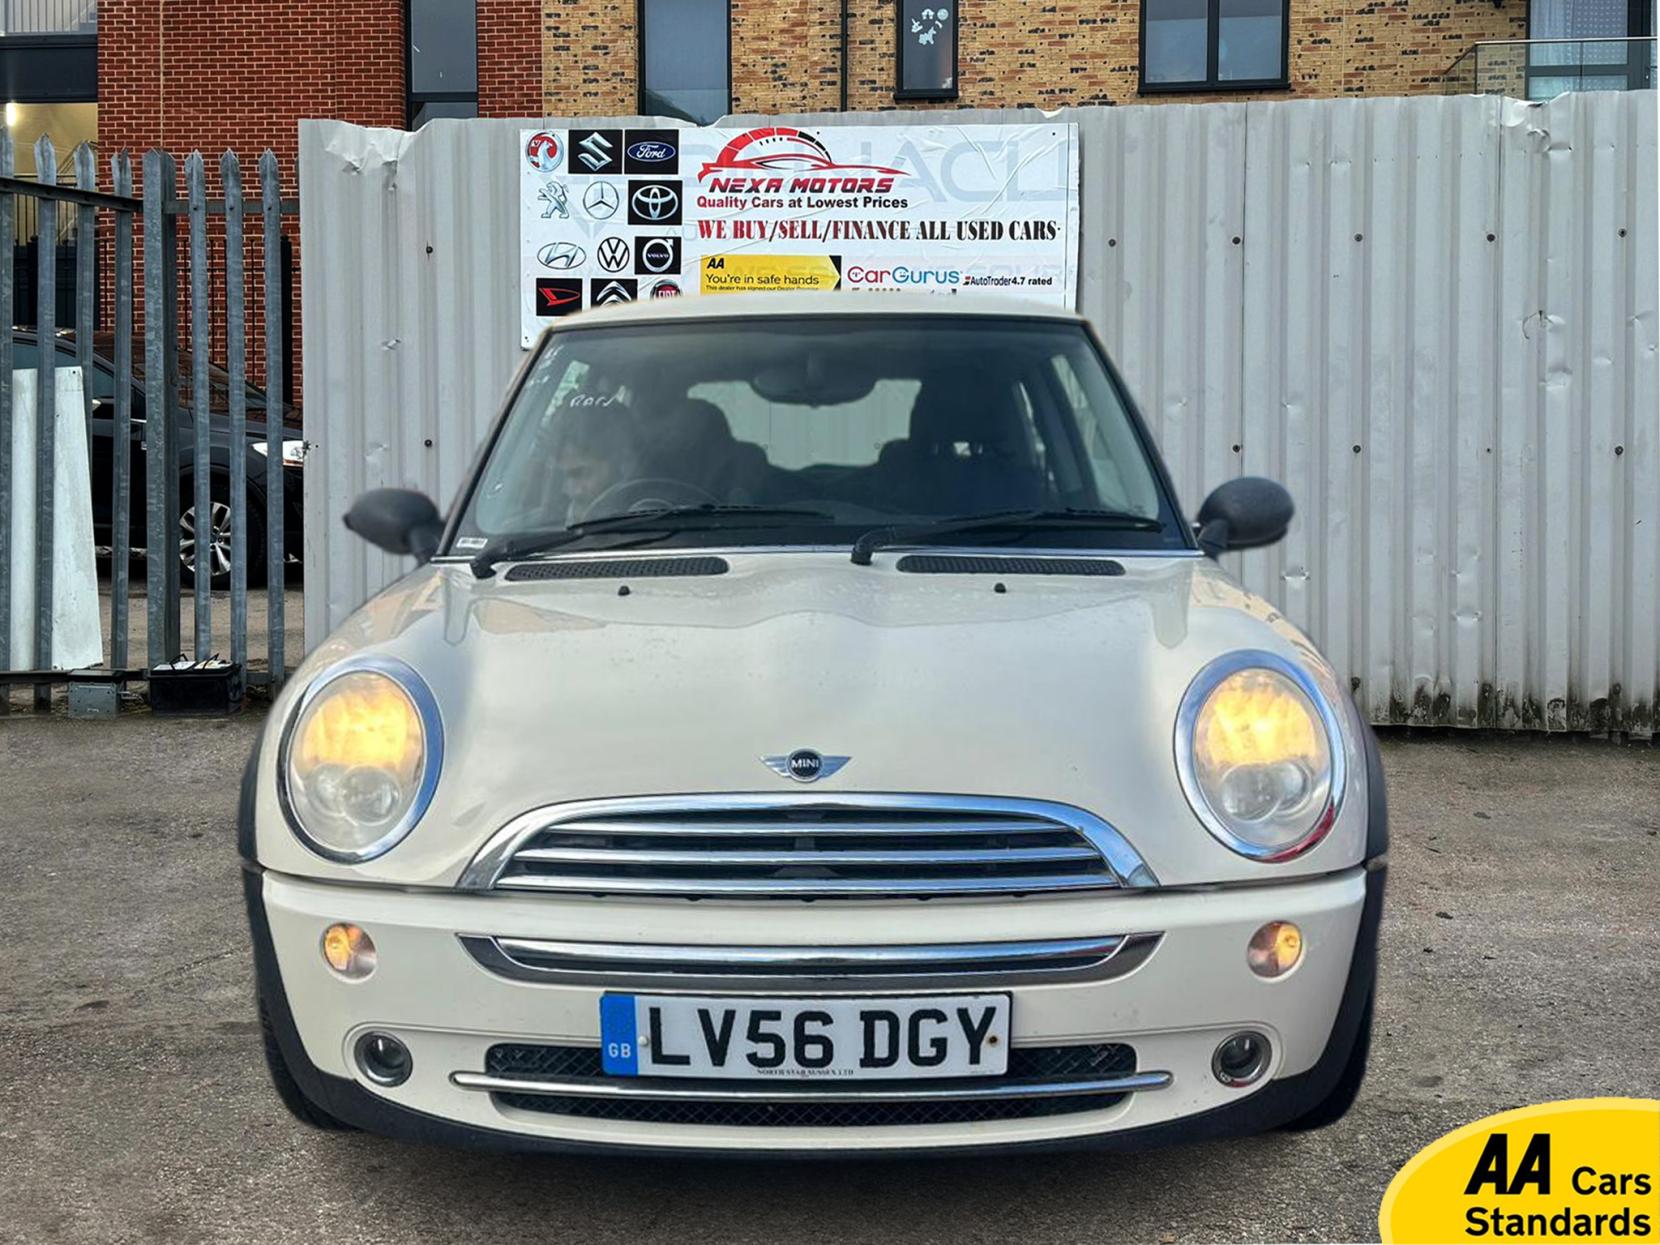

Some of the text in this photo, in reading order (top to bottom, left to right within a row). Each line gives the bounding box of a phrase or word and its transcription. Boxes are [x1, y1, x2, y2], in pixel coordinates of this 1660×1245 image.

[636, 144, 666, 159] Ford
[709, 178, 895, 194] NEXA MOTORS
[697, 195, 908, 210] Quality Cars at Lowest Prices
[697, 219, 727, 240] WE
[733, 219, 911, 242] BUY/SELL/FINANCE
[916, 220, 951, 241] ALL
[956, 220, 1004, 241] USED
[706, 257, 725, 269] AA
[706, 273, 820, 285] You're in safe hands
[847, 266, 960, 284] CarGurus
[1011, 277, 1025, 285] 4.7
[1028, 277, 1052, 285] rated
[791, 758, 819, 769] MINI
[649, 1005, 997, 1069] LV56 DGY
[608, 1043, 631, 1058] GB
